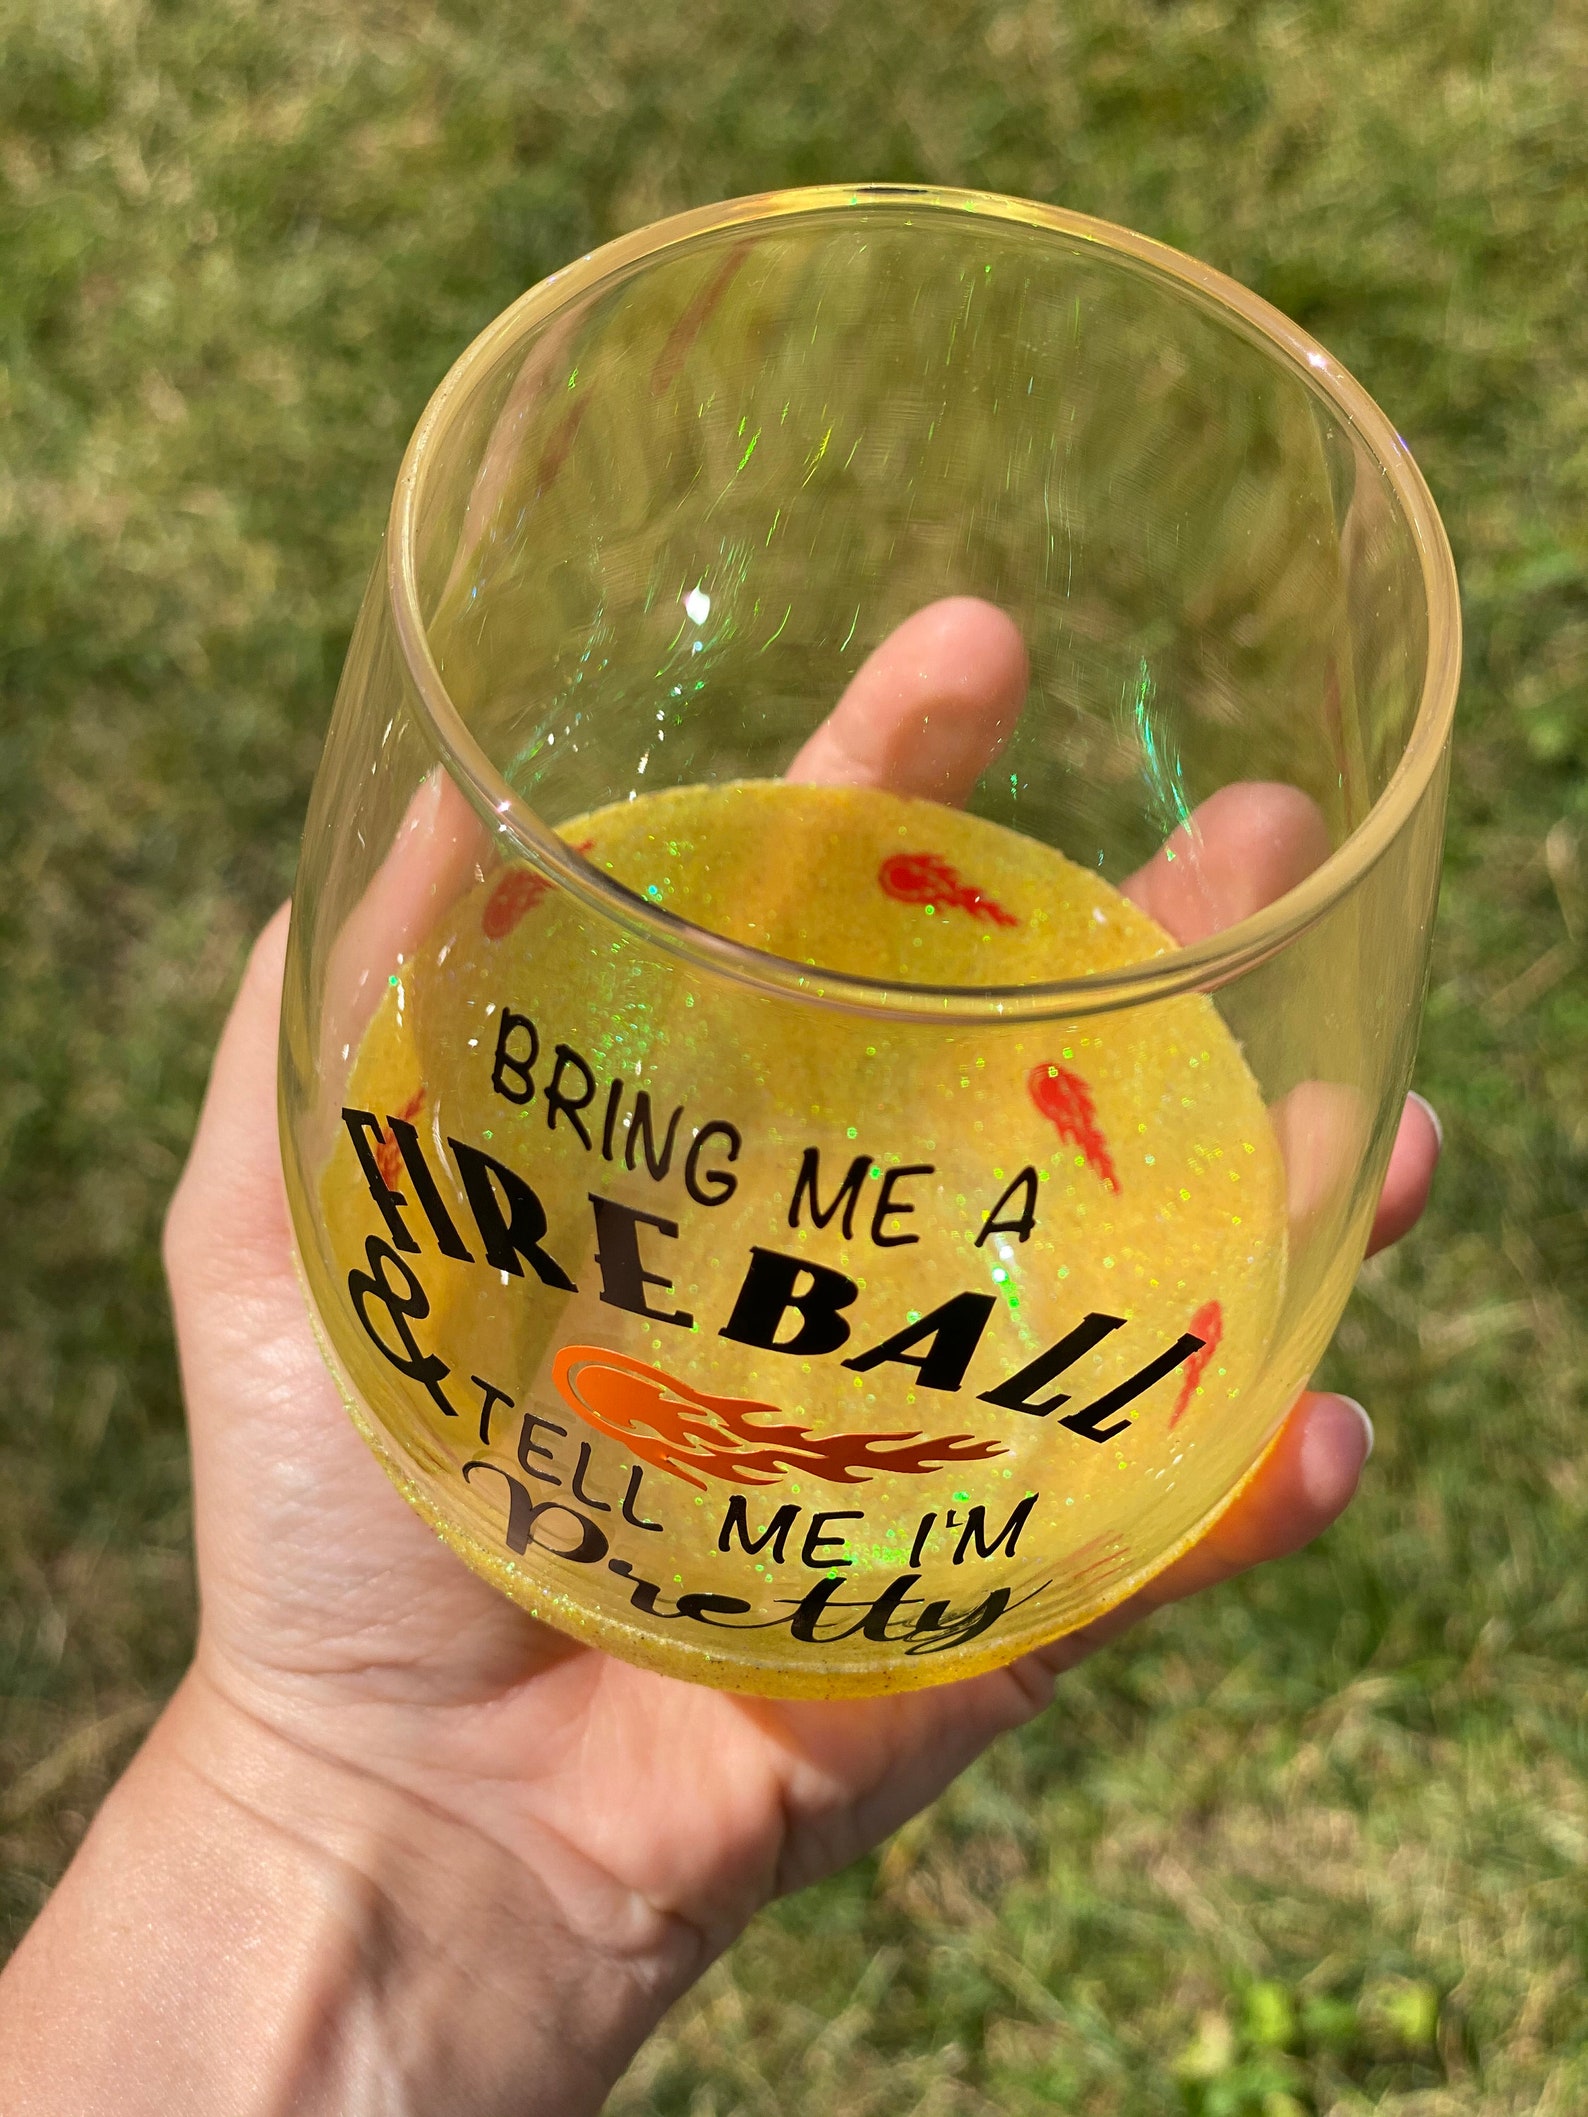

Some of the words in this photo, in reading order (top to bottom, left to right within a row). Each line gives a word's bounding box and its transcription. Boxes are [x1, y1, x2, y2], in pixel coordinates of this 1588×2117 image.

[341, 1107, 1207, 1444] FIREBALL
[491, 1007, 742, 1206] BRING
[788, 1146, 935, 1247] ME
[974, 1165, 1039, 1247] A
[347, 1235, 459, 1417] &
[471, 1375, 663, 1532] TELL
[718, 1495, 865, 1568] ME
[908, 1491, 1040, 1568] I'M
